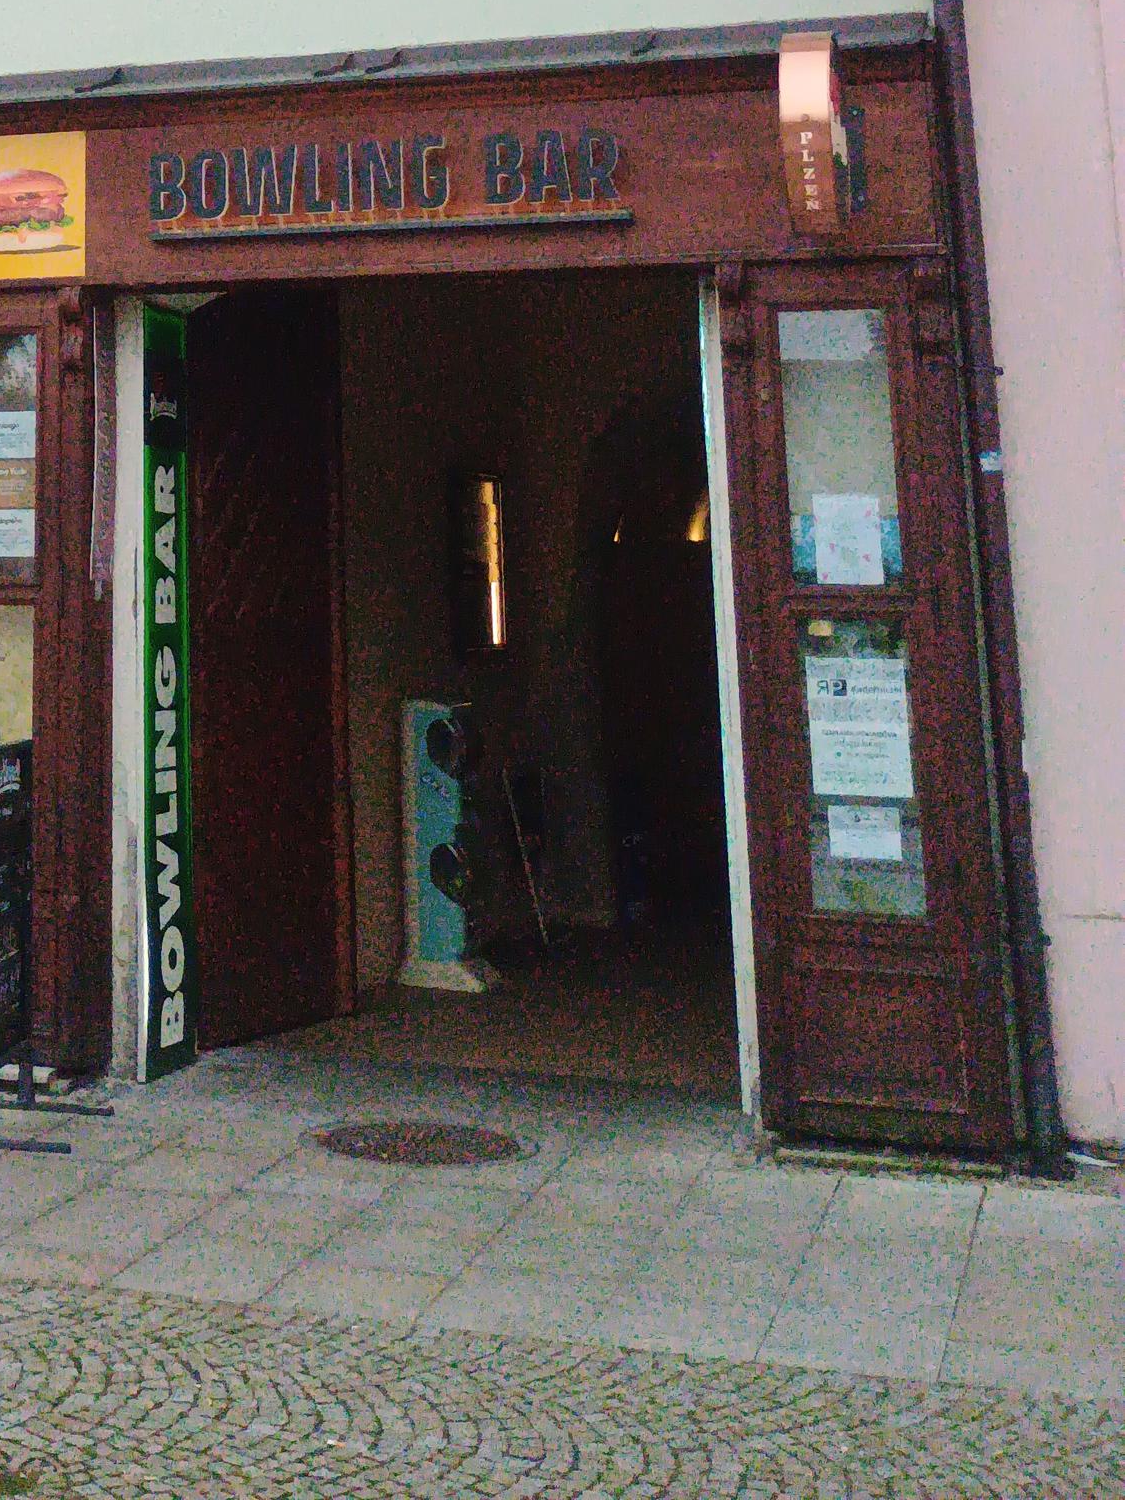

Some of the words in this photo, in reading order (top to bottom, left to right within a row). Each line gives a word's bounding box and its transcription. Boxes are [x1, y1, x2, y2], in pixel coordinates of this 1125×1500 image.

[149, 136, 449, 221] BOWLING
[483, 128, 623, 206] BAR
[154, 464, 177, 624] BAR
[154, 645, 186, 1049] BOWLING
